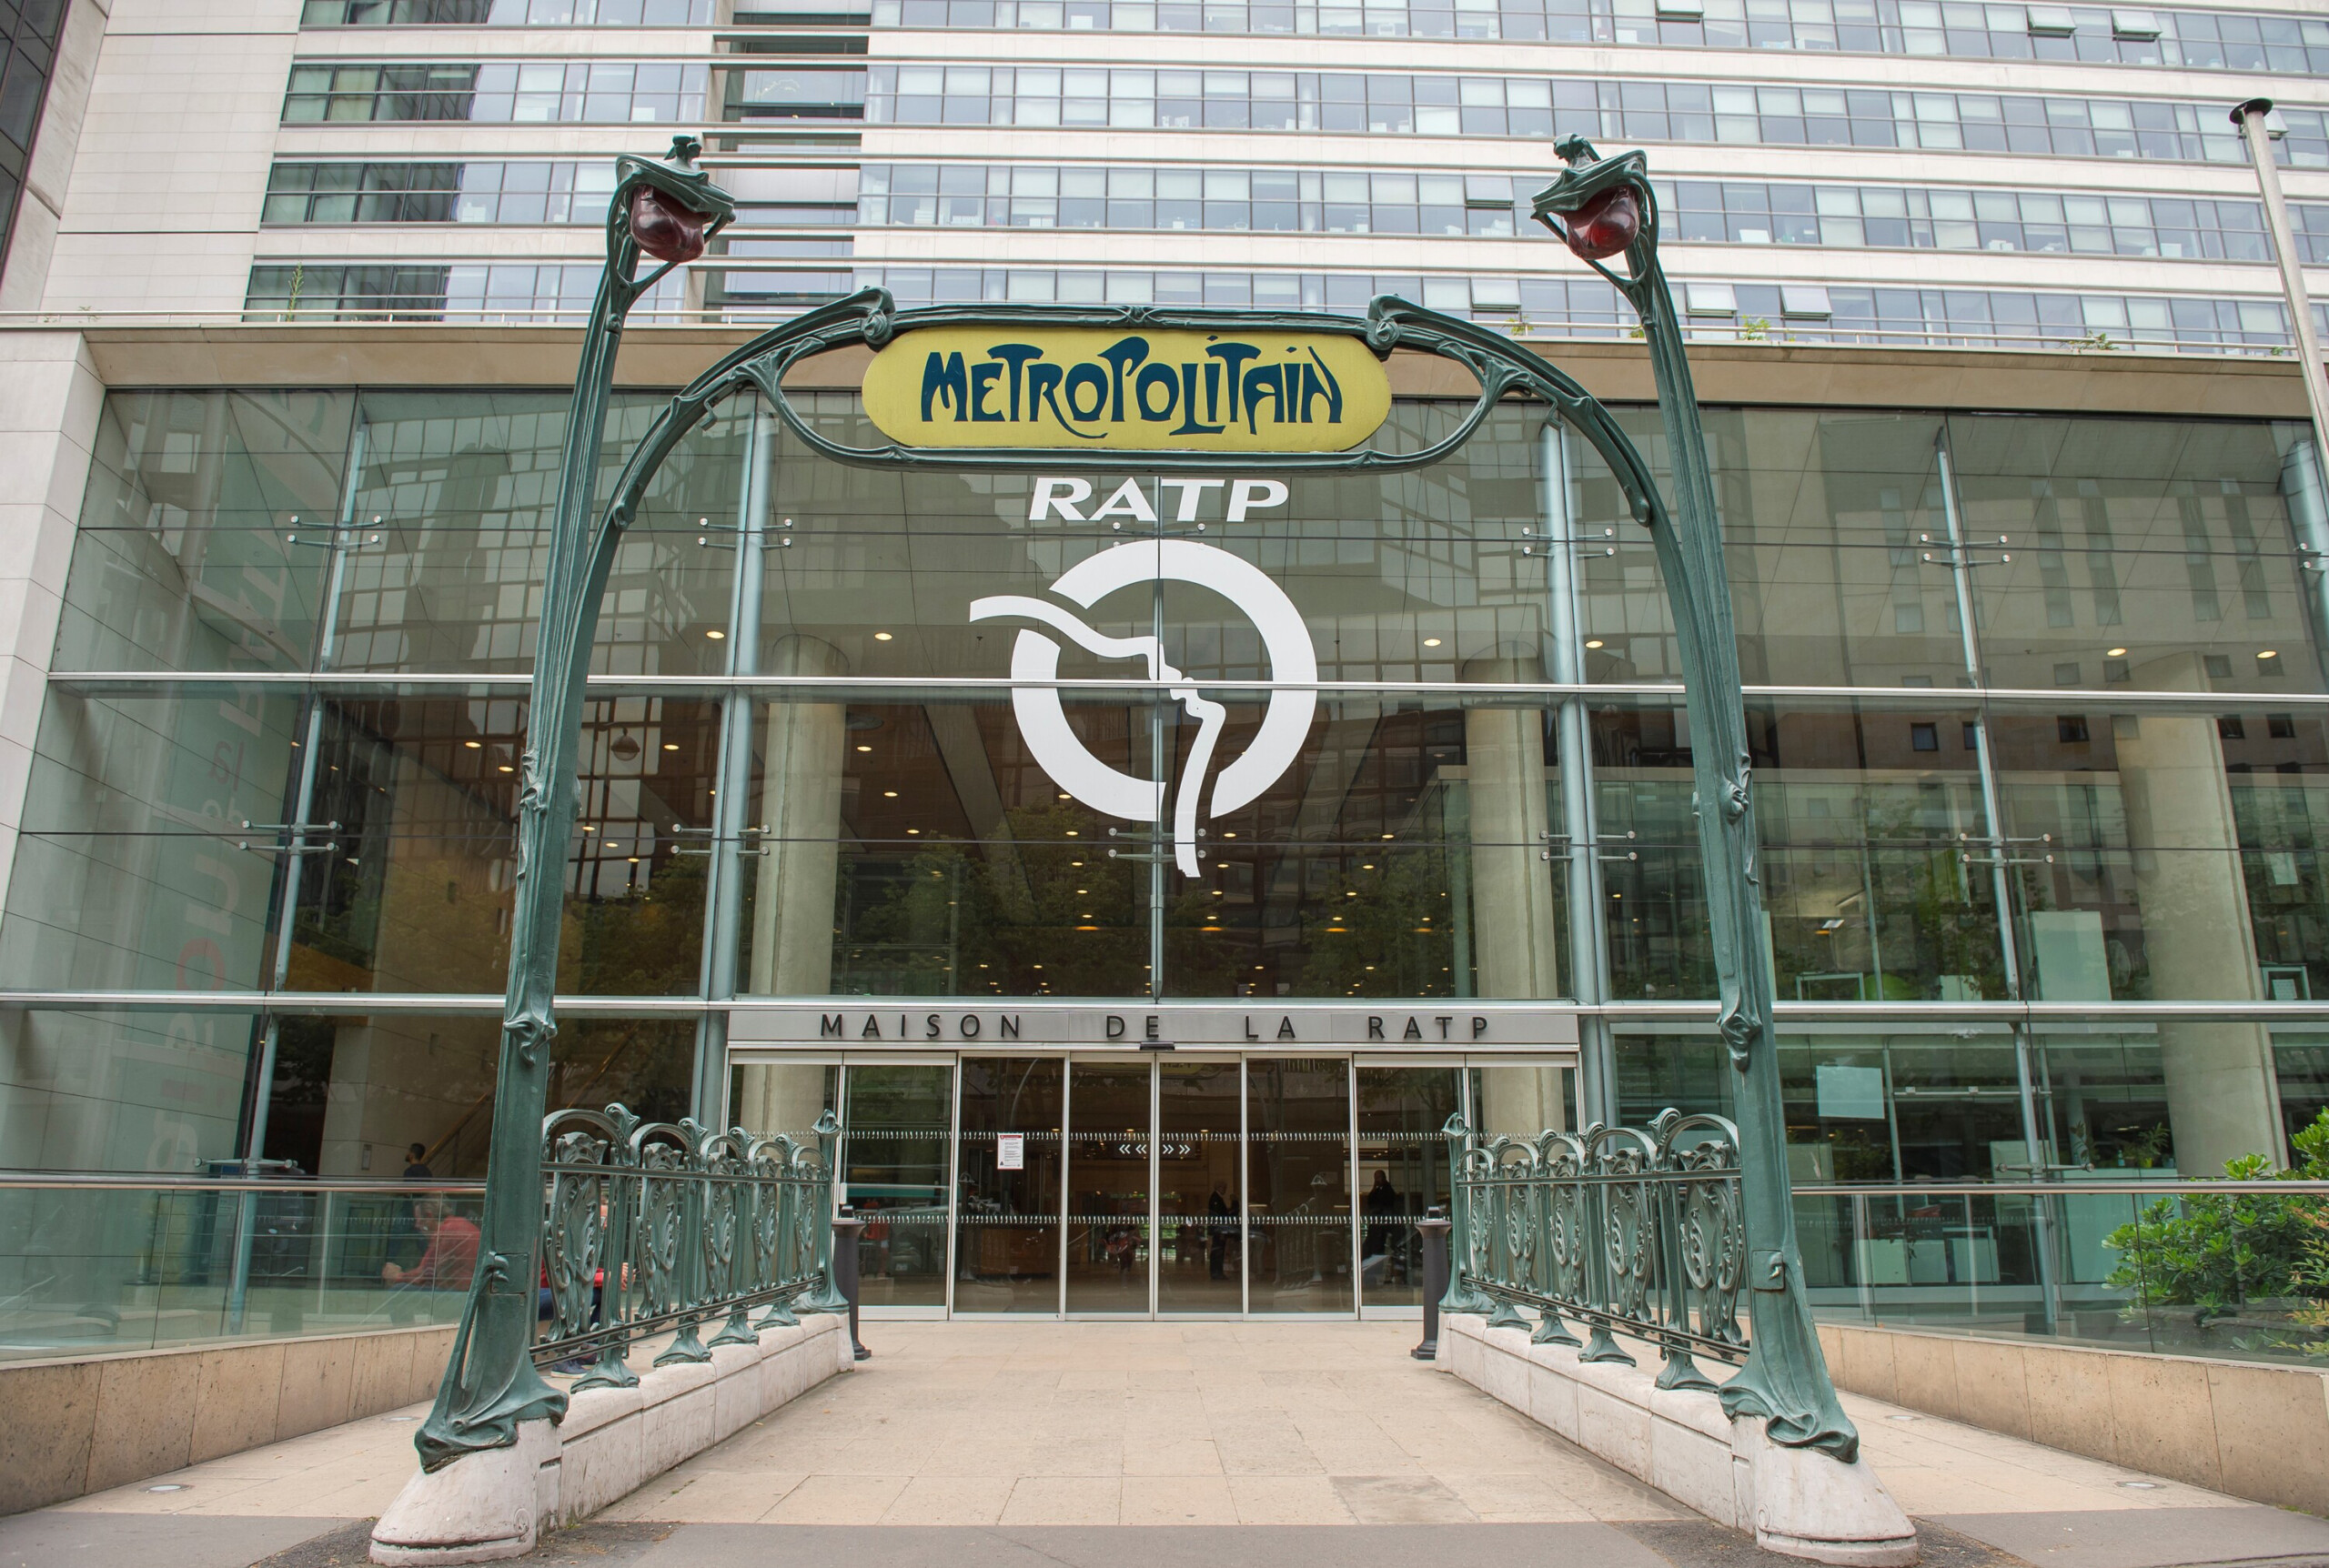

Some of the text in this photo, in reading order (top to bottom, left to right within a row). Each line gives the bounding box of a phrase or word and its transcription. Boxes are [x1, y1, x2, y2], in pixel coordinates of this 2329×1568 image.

[920, 335, 1343, 439] METROPOLITAIN
[1028, 477, 1289, 522] RATP
[820, 1013, 1487, 1040] MAISON DE LA RATP
